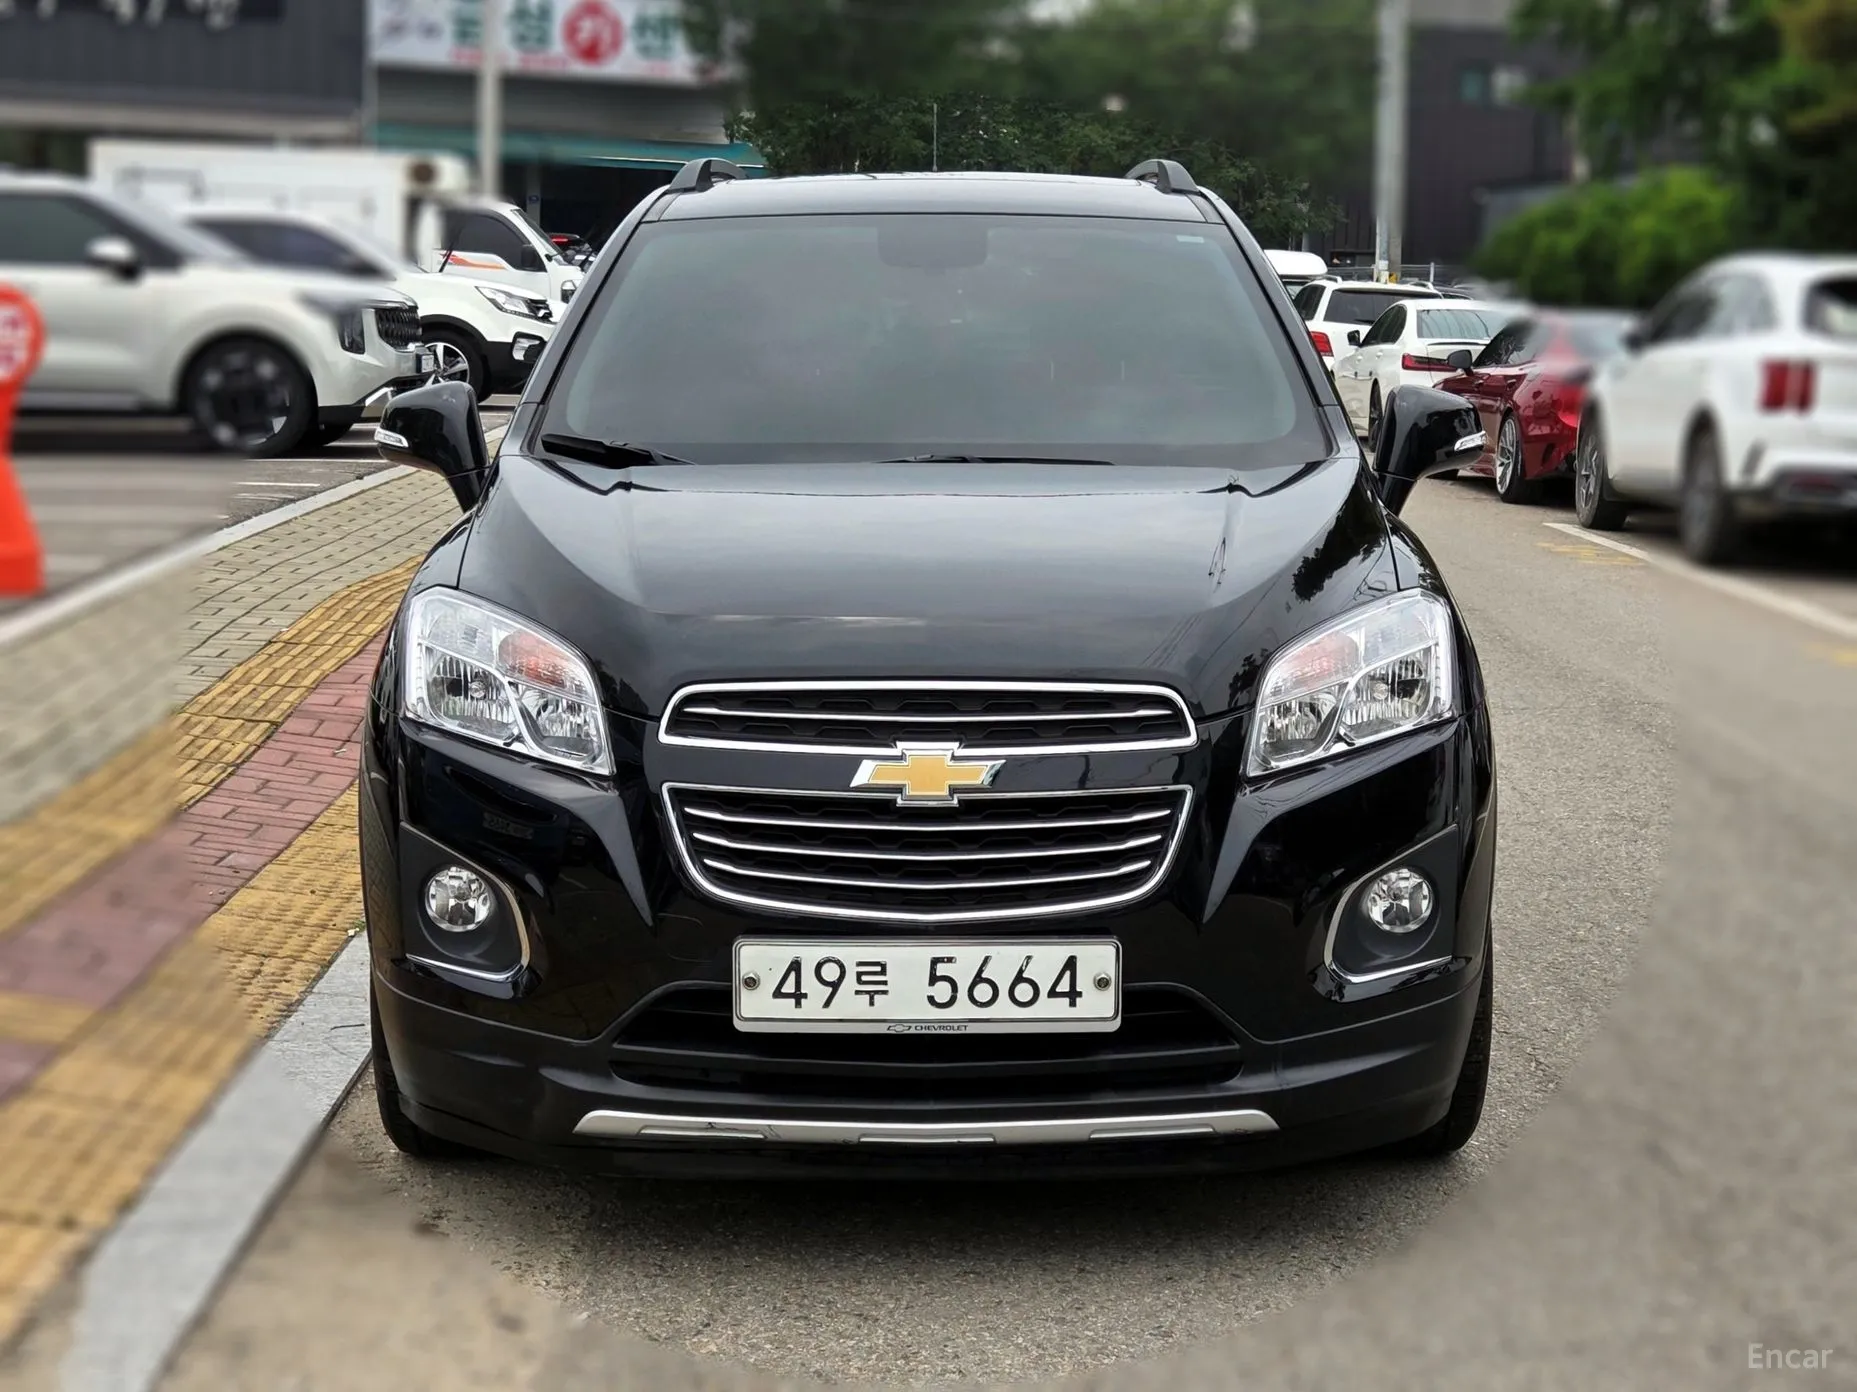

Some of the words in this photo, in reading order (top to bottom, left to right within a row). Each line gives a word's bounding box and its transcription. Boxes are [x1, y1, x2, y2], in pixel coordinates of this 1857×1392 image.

[772, 955, 889, 1009] 49루
[926, 955, 1083, 1009] 5664
[914, 1024, 969, 1032] CHEVROLET
